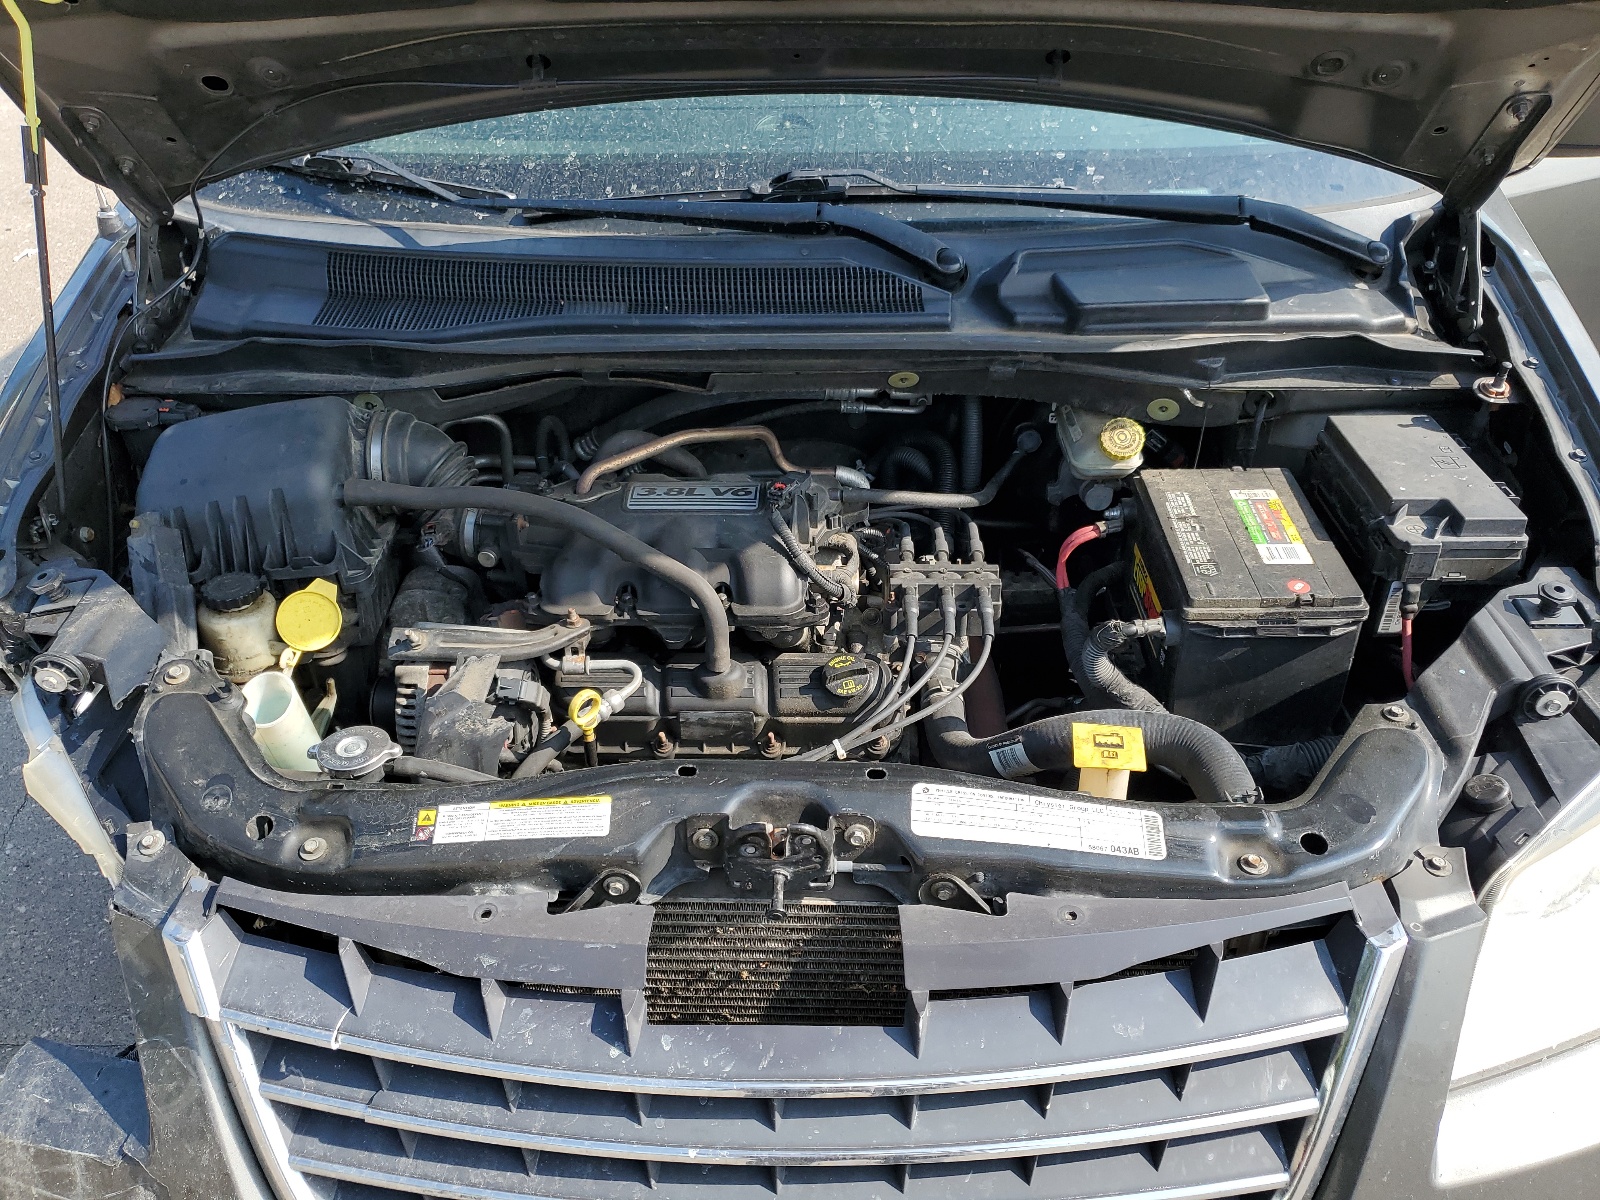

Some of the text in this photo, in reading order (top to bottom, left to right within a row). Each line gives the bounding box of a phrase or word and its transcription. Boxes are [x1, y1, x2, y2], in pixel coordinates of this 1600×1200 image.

[636, 487, 753, 497] 3.8L V6
[828, 656, 847, 667] ENGINE
[1034, 799, 1065, 809] Chrysler
[1110, 844, 1140, 856] 043AB
